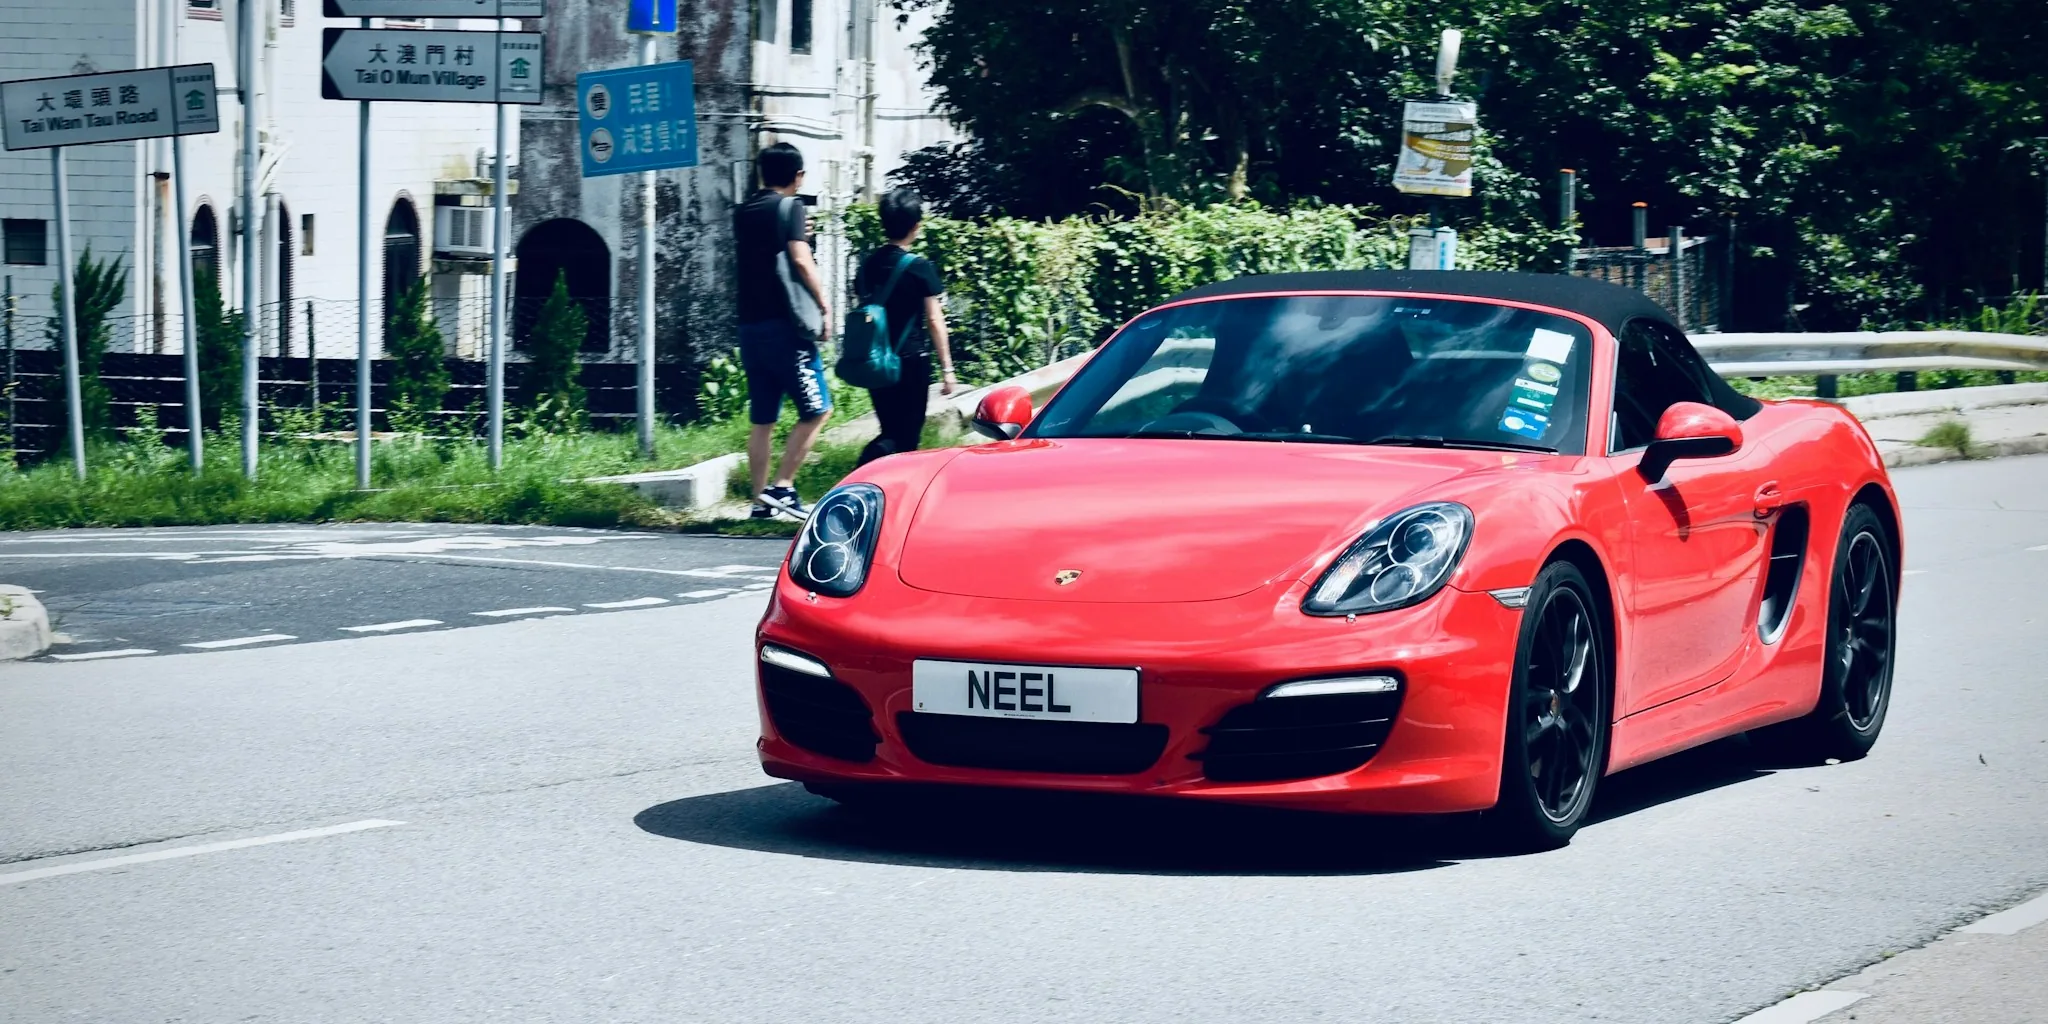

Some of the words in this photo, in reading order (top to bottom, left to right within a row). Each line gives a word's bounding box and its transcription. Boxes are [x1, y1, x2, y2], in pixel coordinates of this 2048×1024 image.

[367, 43, 475, 66] 大澳門村
[354, 69, 379, 83] Tai
[381, 69, 394, 84] O
[396, 70, 431, 84] Mun
[432, 70, 486, 89] Village
[36, 84, 140, 112] 大環頭路
[20, 119, 45, 133] Tai
[46, 116, 83, 131] Wan
[84, 113, 114, 128] Tau
[116, 108, 159, 125] Road
[621, 120, 688, 155] 減速慢行
[968, 670, 1071, 713] NEEL
